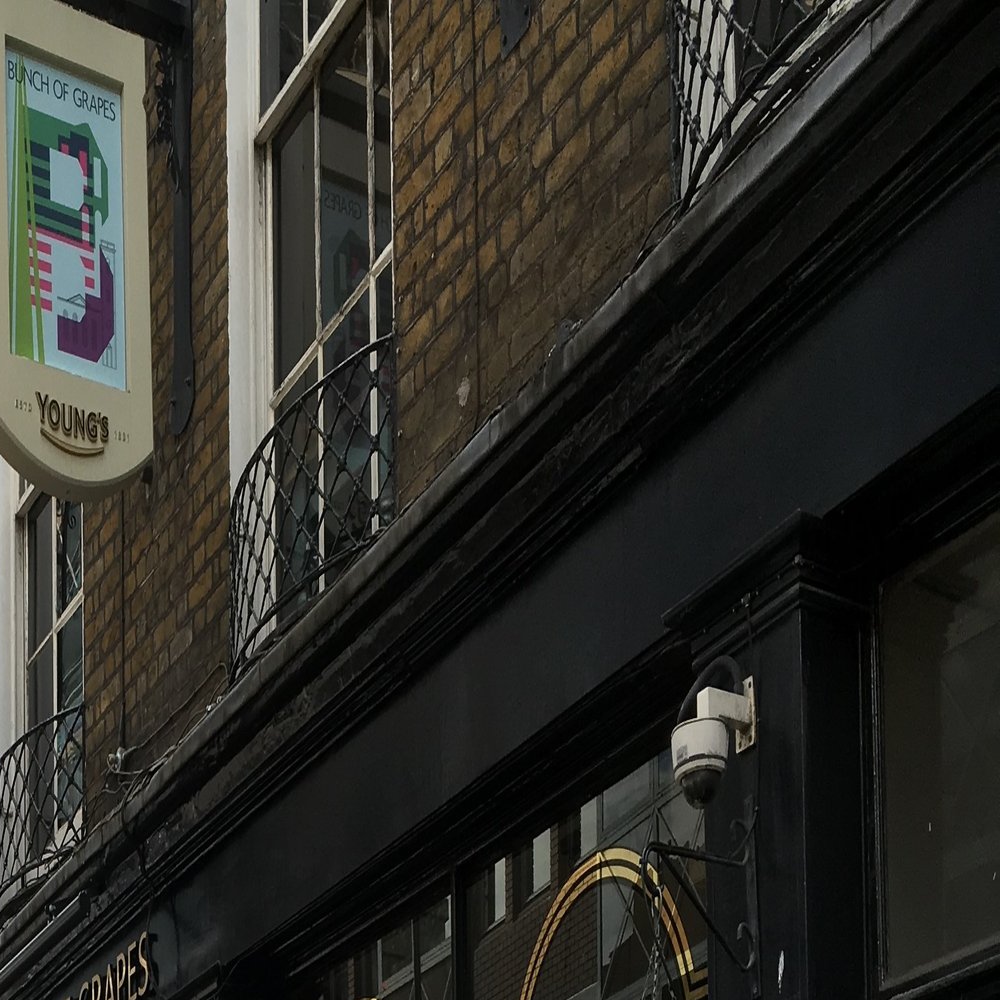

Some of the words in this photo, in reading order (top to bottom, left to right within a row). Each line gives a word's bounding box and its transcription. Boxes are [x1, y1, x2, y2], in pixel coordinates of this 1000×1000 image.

[7, 59, 50, 96] BUNCH
[52, 79, 69, 102] OF
[73, 88, 116, 122] GRAPES
